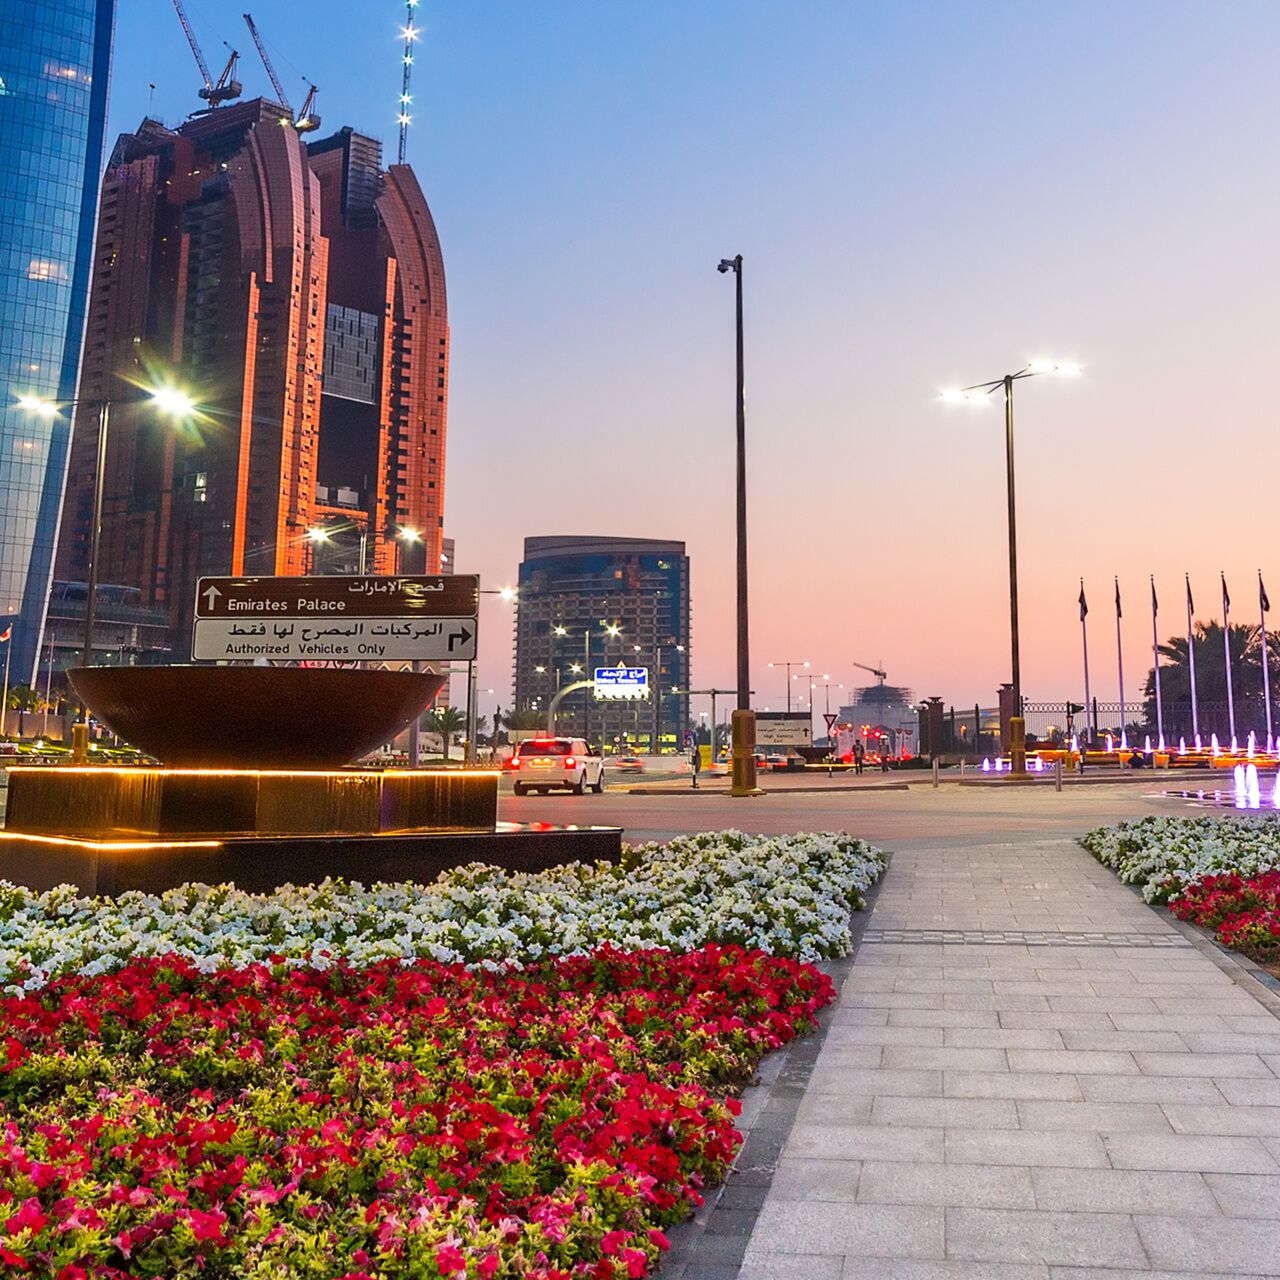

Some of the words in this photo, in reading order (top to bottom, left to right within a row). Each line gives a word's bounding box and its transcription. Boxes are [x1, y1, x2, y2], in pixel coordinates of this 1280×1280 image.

[228, 599, 288, 611] Emirates
[297, 599, 346, 611] Palace
[228, 622, 267, 636] فقط
[273, 623, 294, 637] لها
[301, 622, 363, 641] المصرح
[370, 622, 443, 640] المركبات
[225, 643, 290, 654] Authorized
[298, 643, 349, 654] Vehicles
[357, 643, 386, 655] Only
